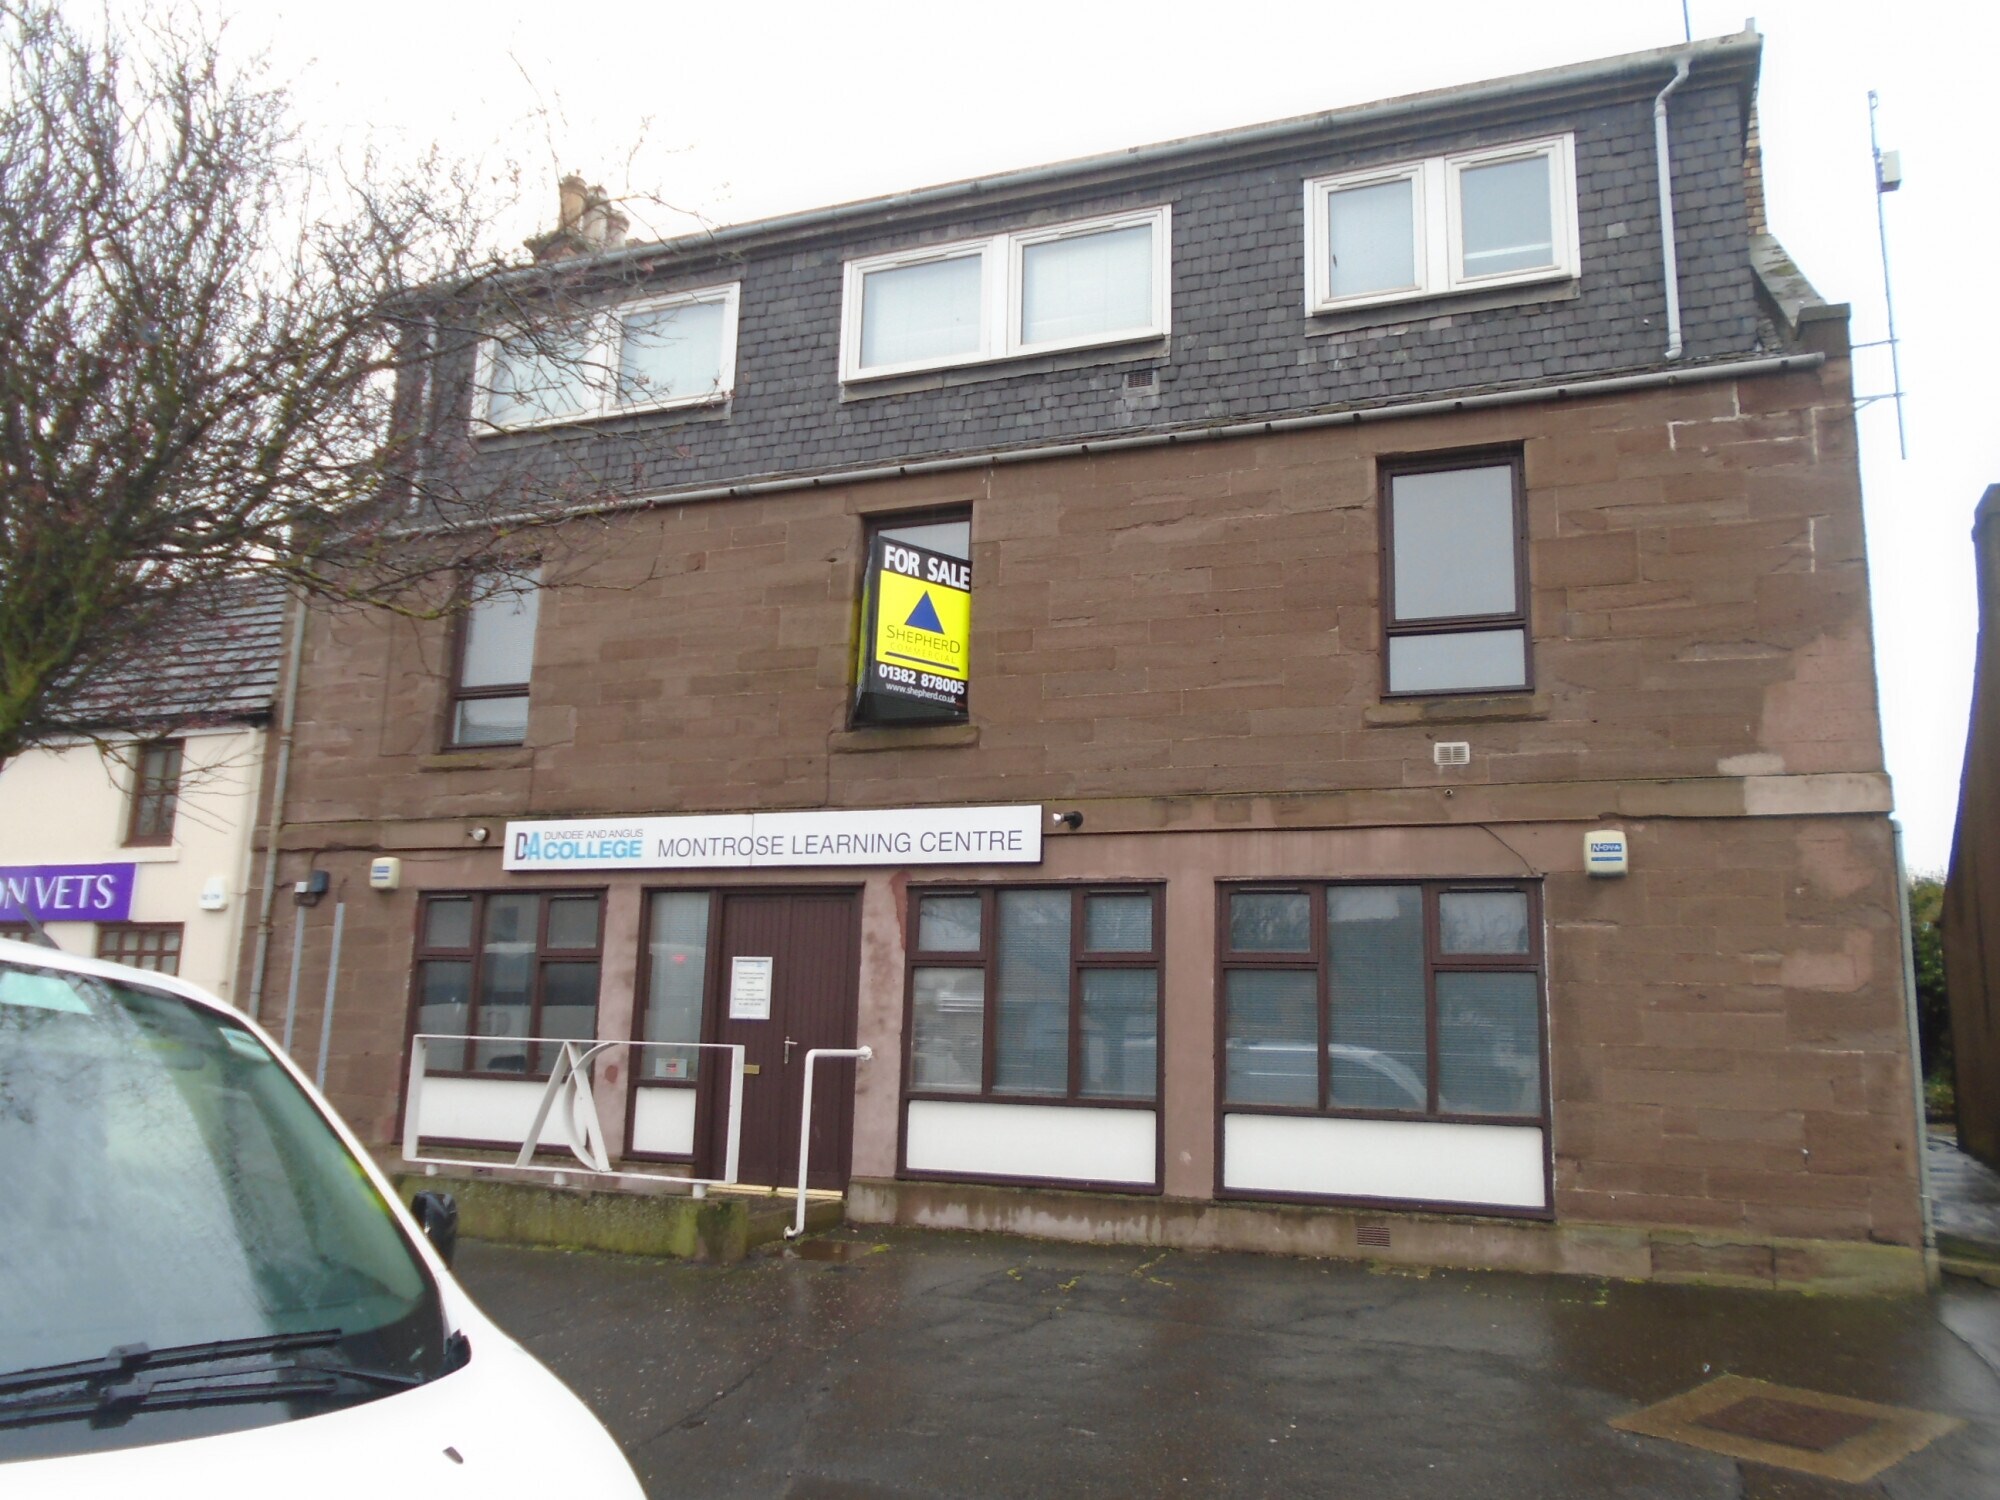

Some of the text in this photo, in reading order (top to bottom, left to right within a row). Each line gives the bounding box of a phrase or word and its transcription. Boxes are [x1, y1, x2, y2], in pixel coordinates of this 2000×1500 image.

[884, 546, 970, 590] FOR SALE
[886, 624, 961, 654] SHEPHERD
[890, 641, 956, 664] COMMERCIAL
[879, 664, 965, 695] 01382 878005
[885, 682, 956, 704] www.shepherd.co.uk
[544, 828, 644, 840] DUNDEE AND ANGUS
[657, 830, 1023, 858] MONTROSE LEARNING CENTRE
[543, 840, 643, 860] COLLEGE
[35, 874, 119, 909] VETS
